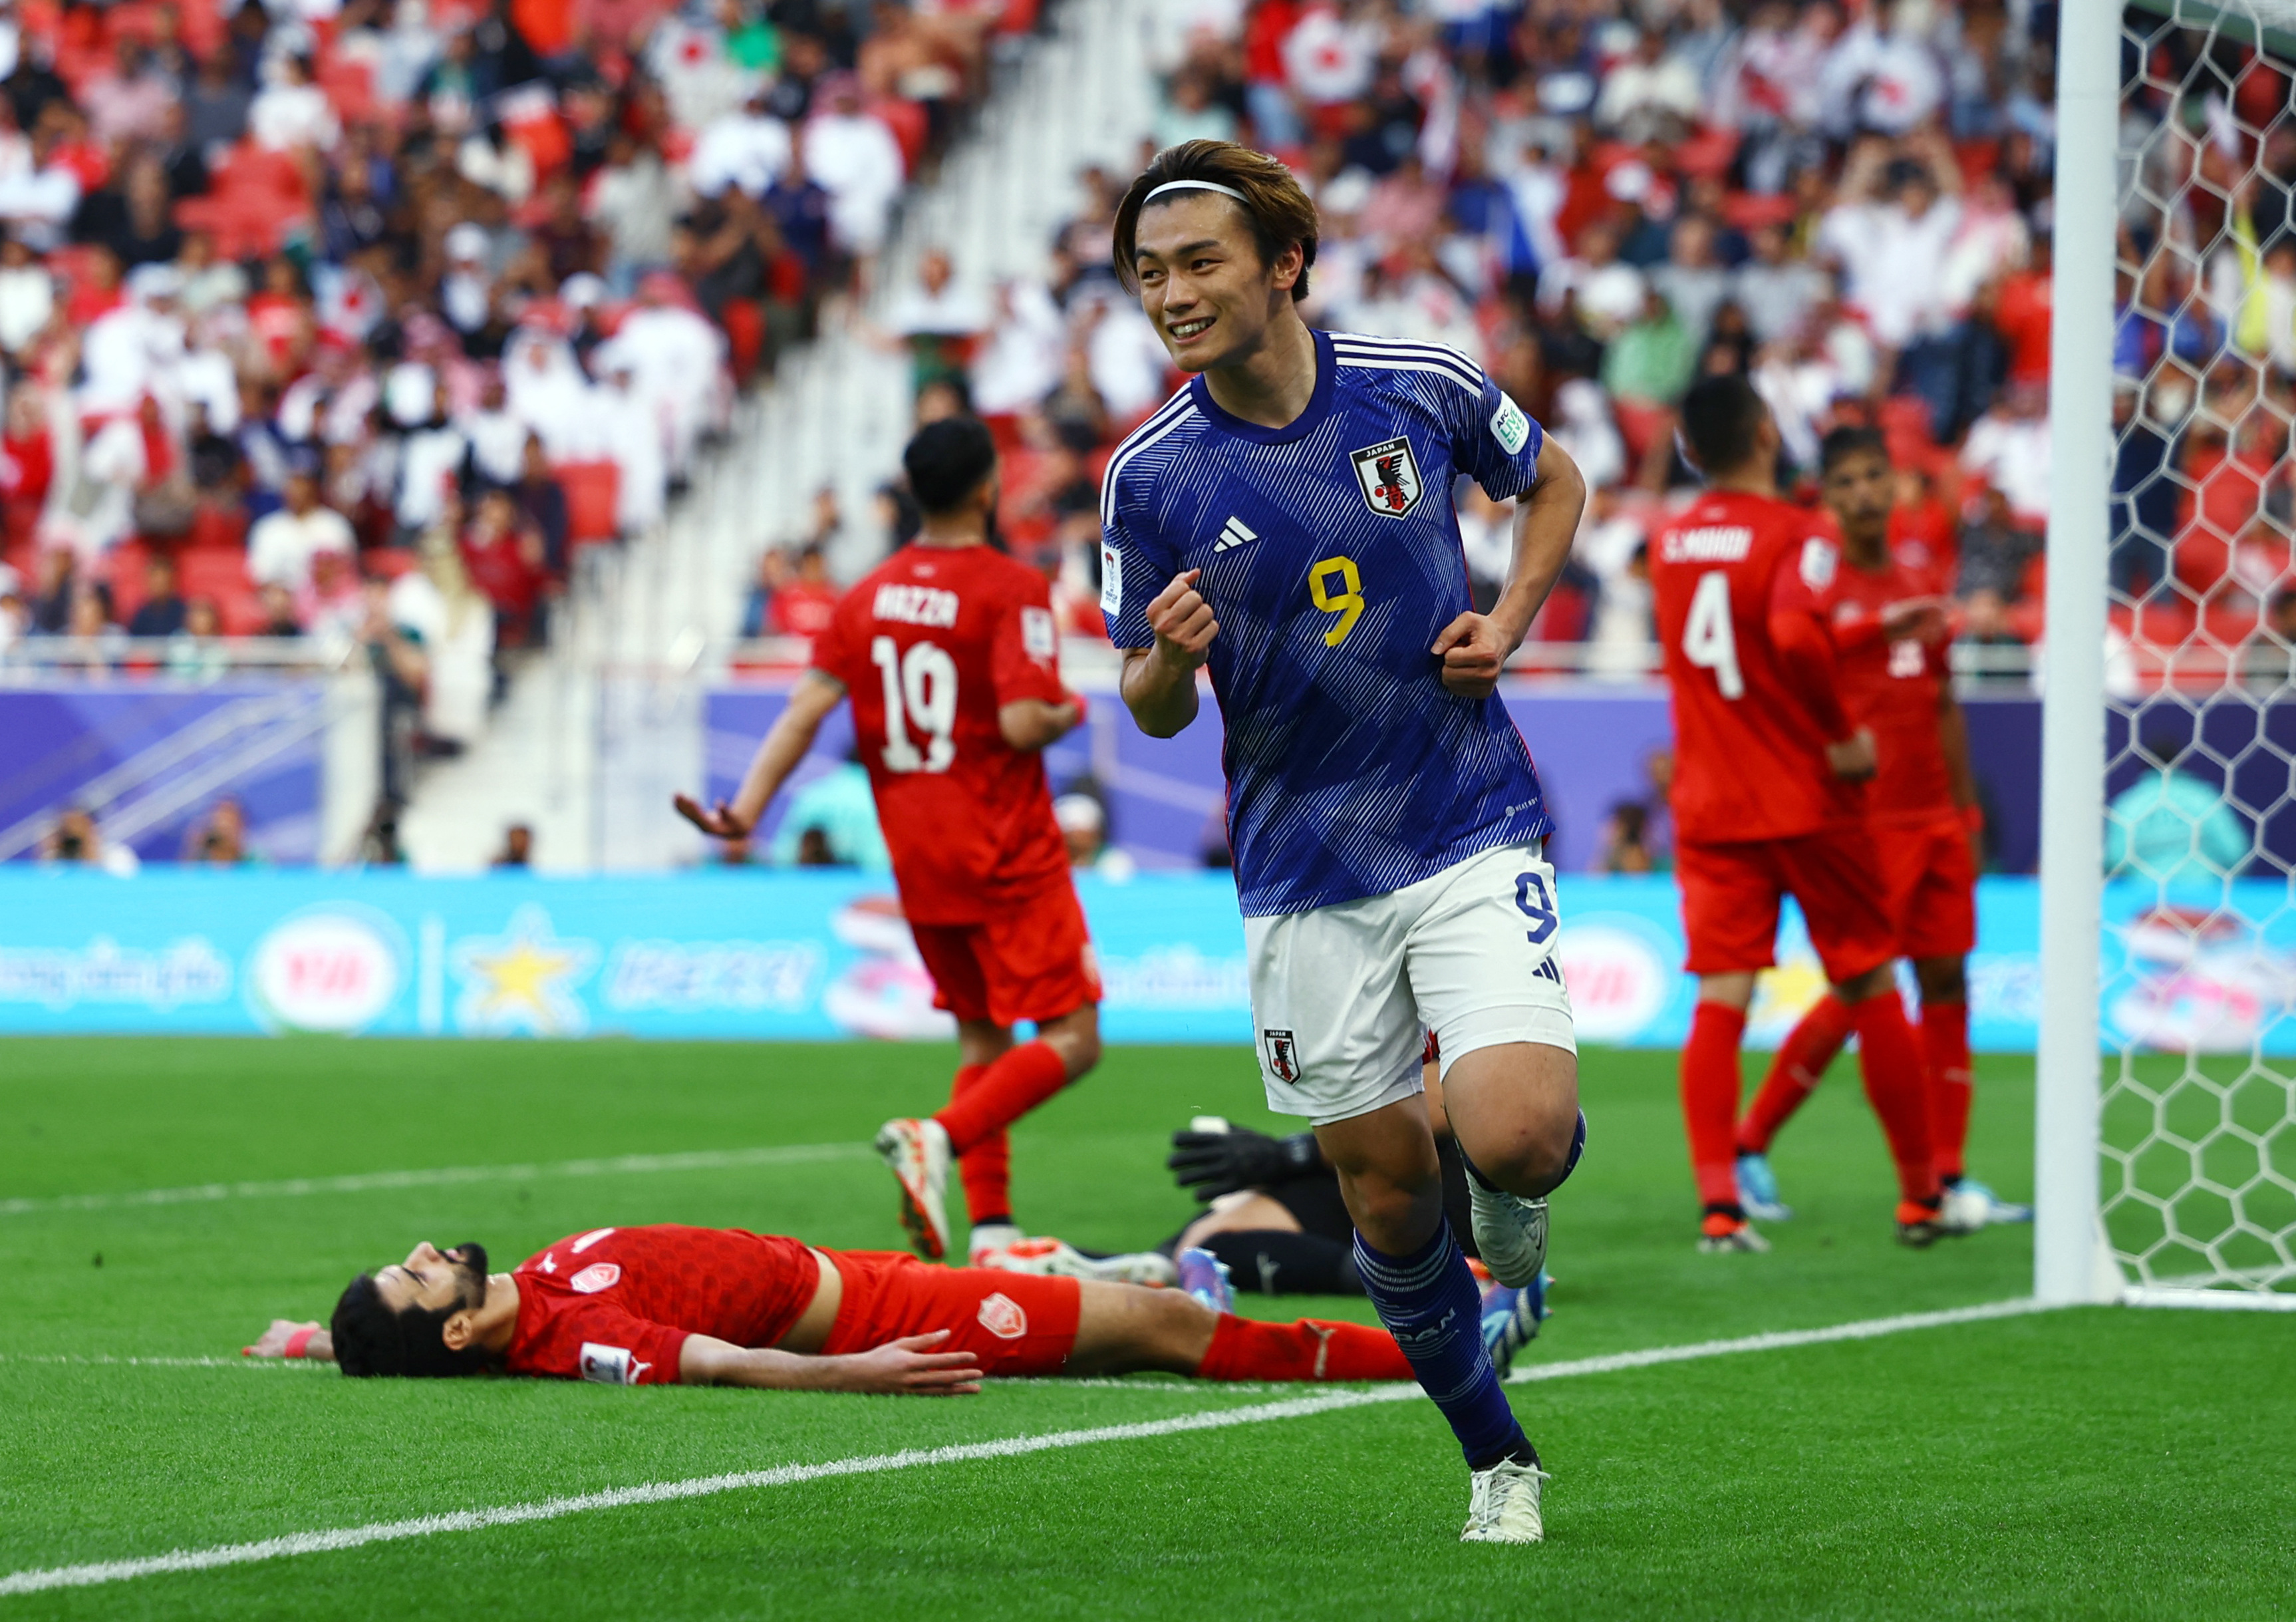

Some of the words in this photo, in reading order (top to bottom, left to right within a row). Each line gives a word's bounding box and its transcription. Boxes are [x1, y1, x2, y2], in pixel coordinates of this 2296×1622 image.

[1366, 443, 1395, 457] JAPAN
[1497, 409, 1508, 429] AFC
[1501, 406, 1517, 438] LIVE
[1308, 556, 1364, 647] 9
[1682, 570, 1745, 701] 4
[872, 635, 958, 774] 19
[1515, 872, 1557, 944] 9
